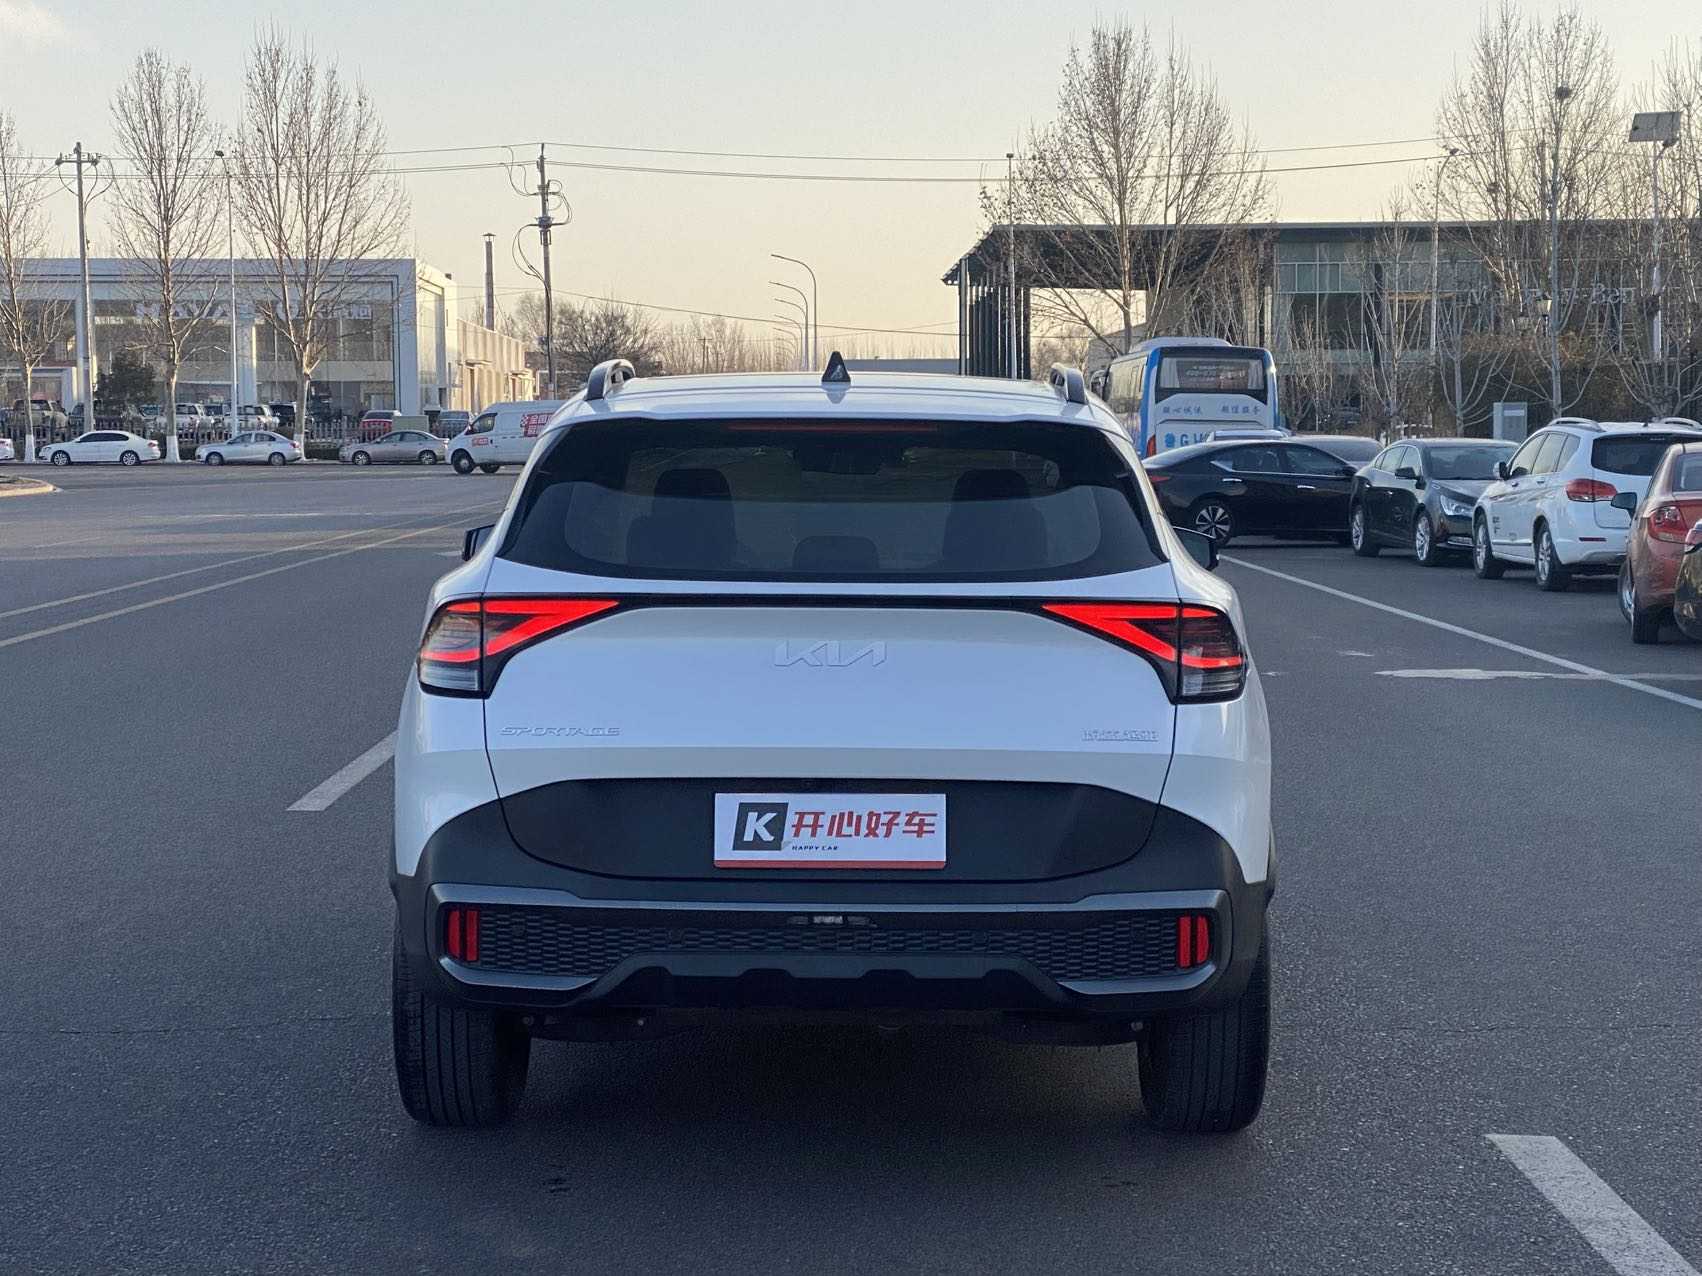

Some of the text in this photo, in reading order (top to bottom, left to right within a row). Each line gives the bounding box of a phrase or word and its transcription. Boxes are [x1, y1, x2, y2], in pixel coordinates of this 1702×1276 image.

[773, 640, 888, 667] KIA
[500, 726, 622, 737] SPORTAGE
[791, 810, 938, 839] 开心好车
